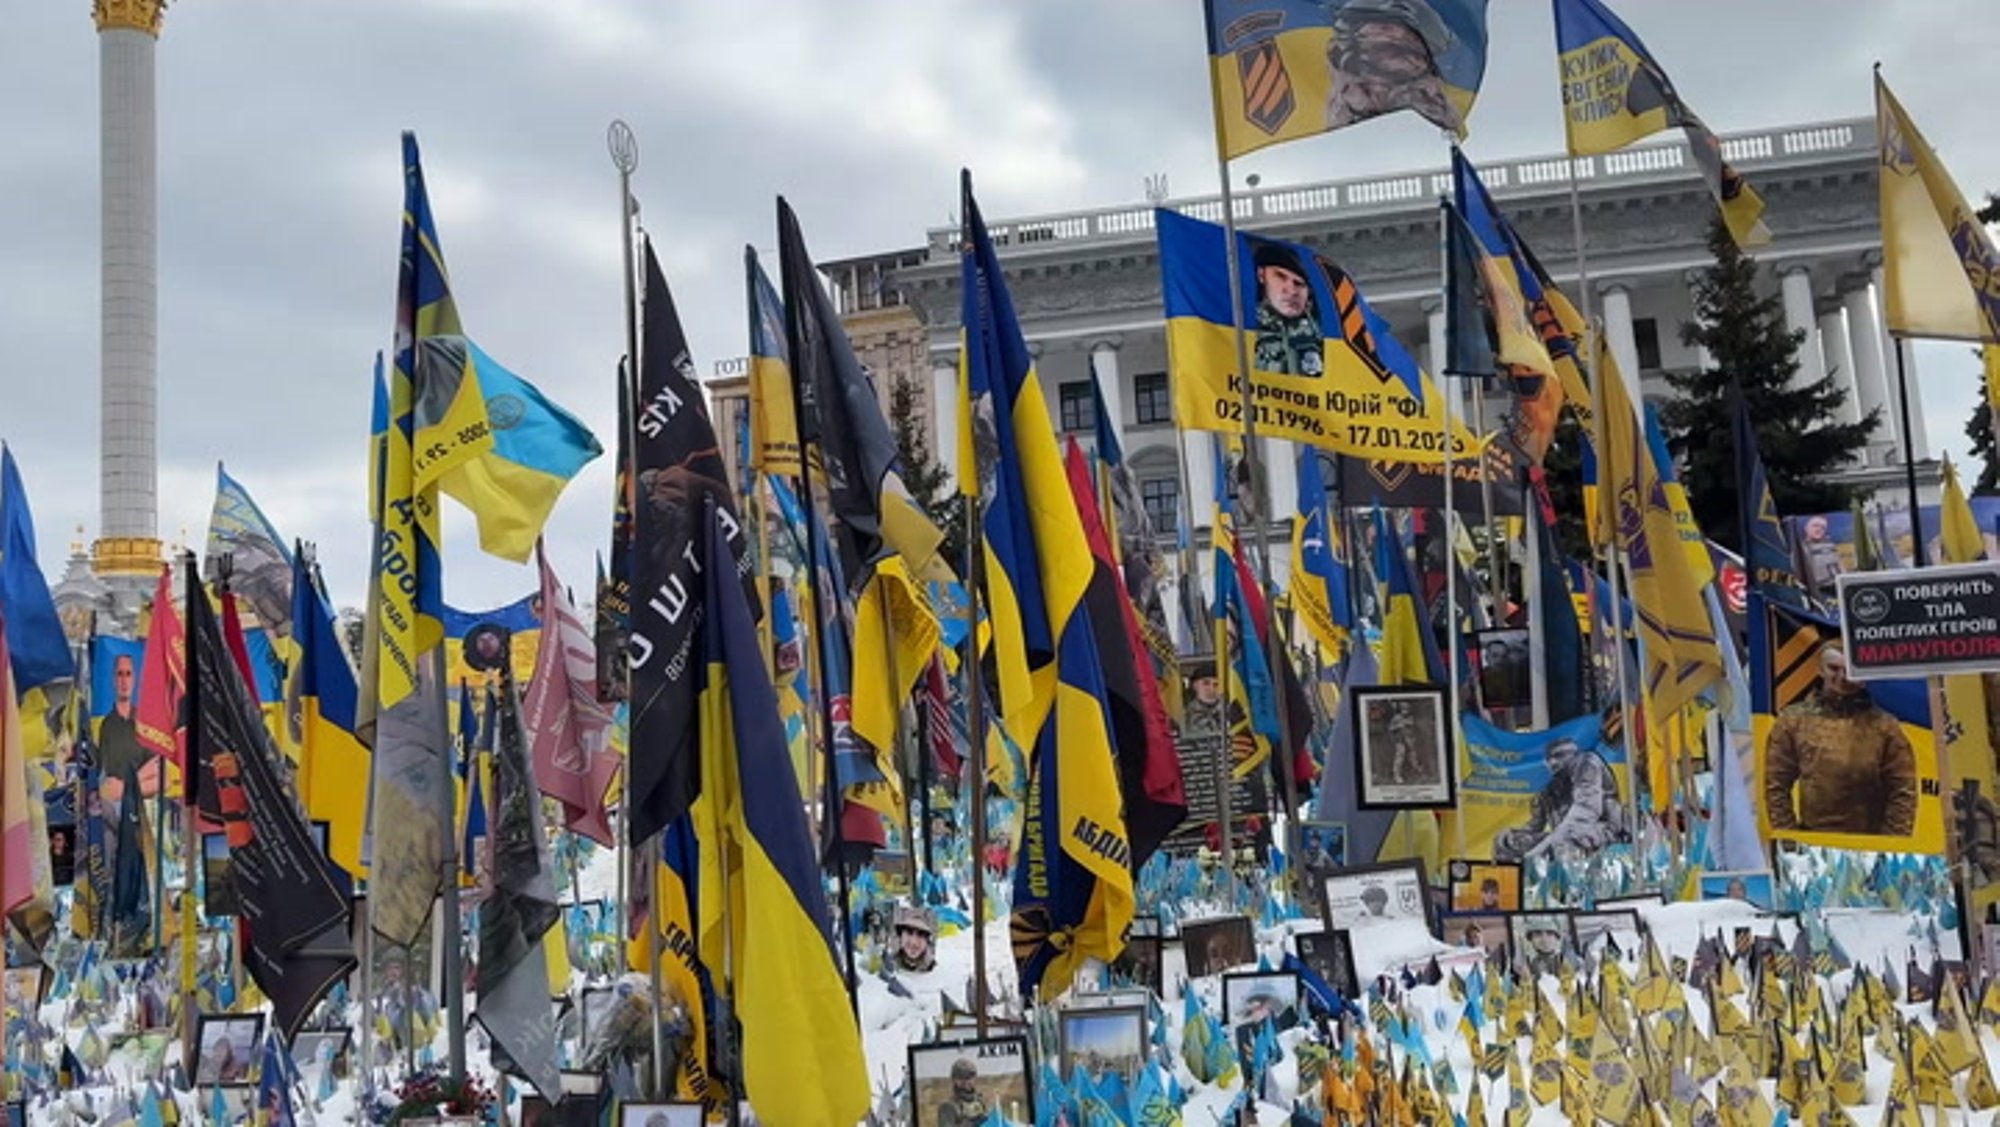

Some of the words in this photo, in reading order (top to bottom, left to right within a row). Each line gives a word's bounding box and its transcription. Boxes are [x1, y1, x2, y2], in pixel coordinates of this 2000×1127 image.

[1326, 390, 1381, 419] Юрій
[1894, 580, 1994, 600] ПОВЕРНІТЬ
[1924, 602, 1967, 617] ТІЛА
[1855, 622, 1939, 640] ПОЛЕГЛИХ
[1941, 617, 1997, 635] ГЕРОЇВ
[1858, 636, 2000, 662] МАРІУПОЛЯ
